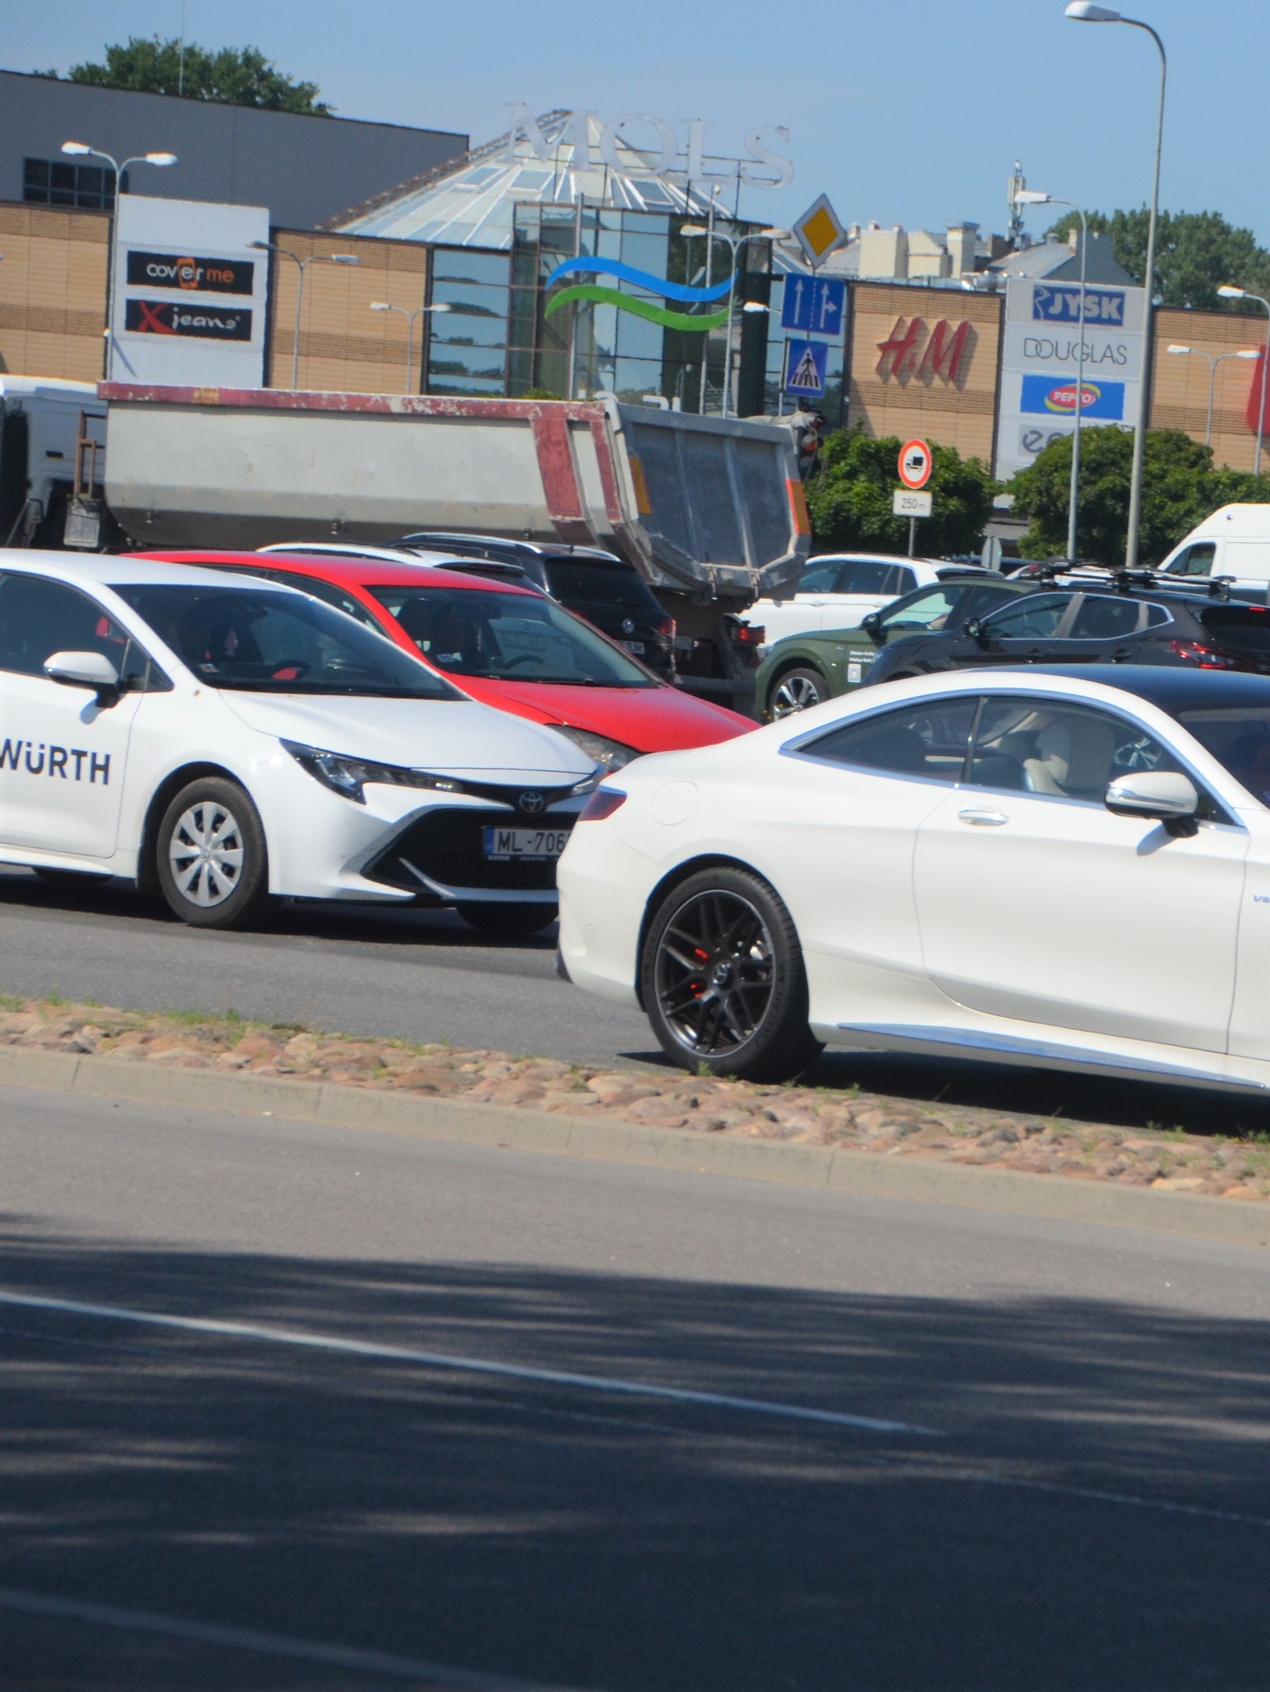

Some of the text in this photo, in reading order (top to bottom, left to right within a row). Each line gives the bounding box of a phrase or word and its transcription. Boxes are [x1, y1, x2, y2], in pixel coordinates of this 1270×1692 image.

[497, 102, 795, 189] MOLS
[146, 262, 235, 283] cover me
[1048, 292, 1122, 320] JYSK
[875, 315, 970, 381] H&M
[1023, 337, 1128, 366] DOUGLAS
[902, 498, 917, 509] 250
[497, 830, 571, 853] ML-706
